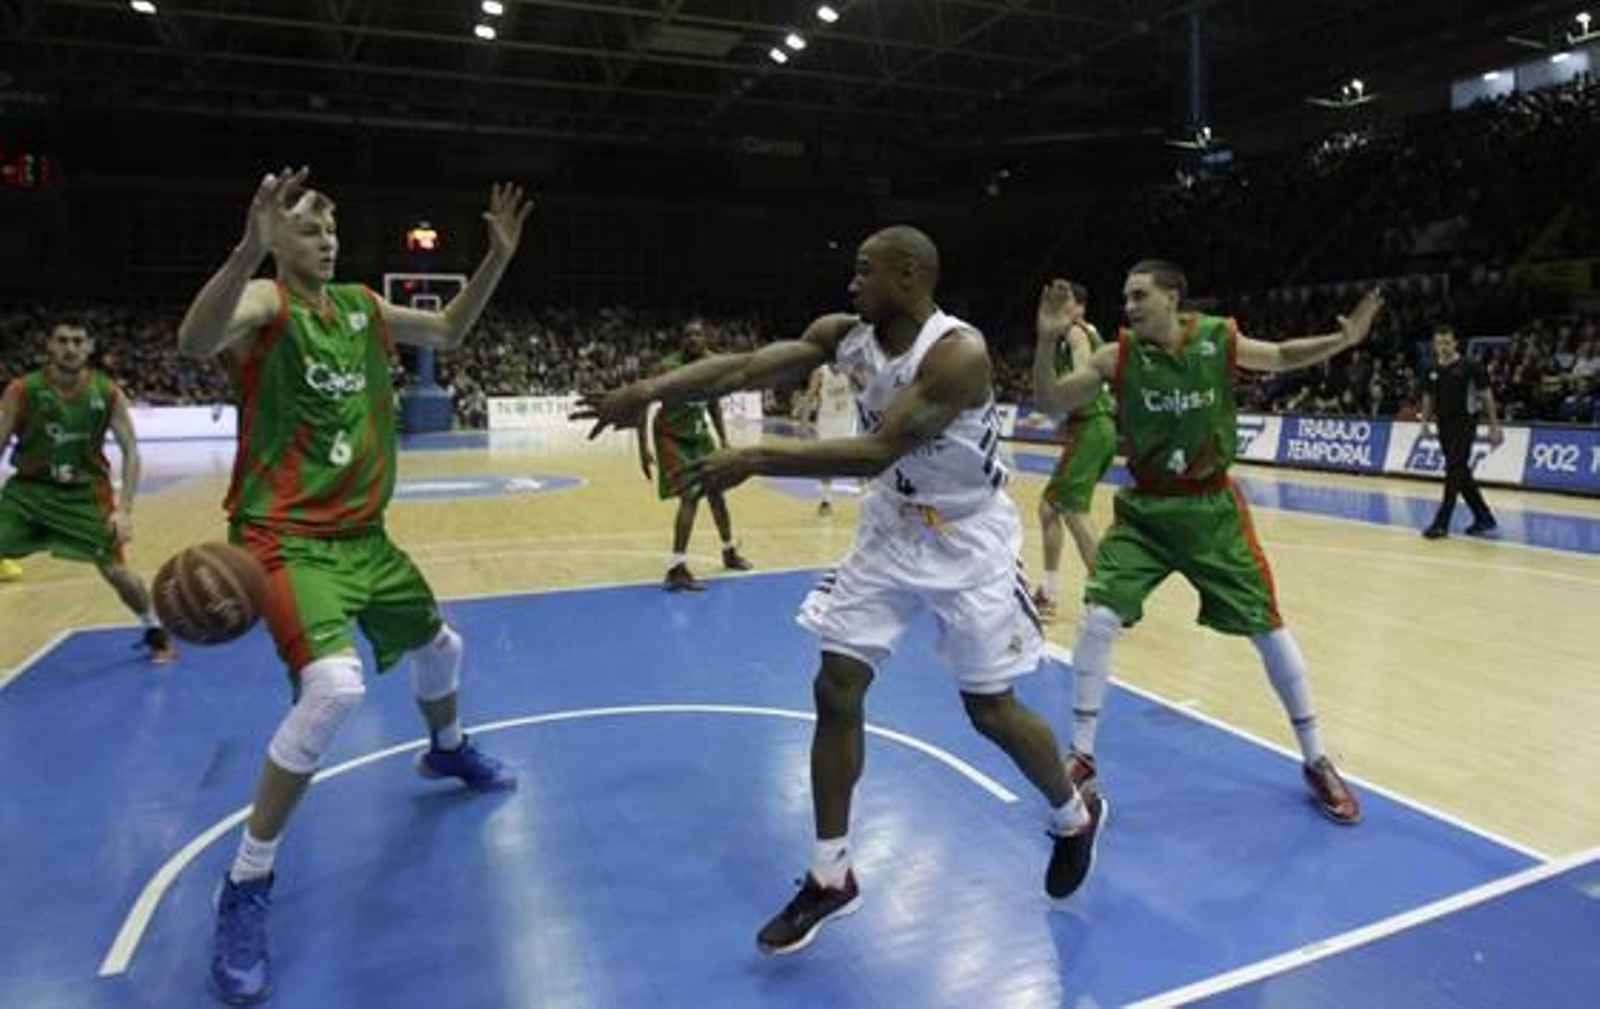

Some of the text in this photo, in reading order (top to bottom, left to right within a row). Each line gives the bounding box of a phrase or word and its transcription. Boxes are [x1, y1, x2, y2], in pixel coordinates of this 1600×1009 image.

[1298, 418, 1371, 442] TRABAJO
[329, 430, 352, 466] 6
[1167, 449, 1188, 475] 4
[1287, 438, 1372, 466] TEMPORAL
[1532, 443, 1579, 472] 902
